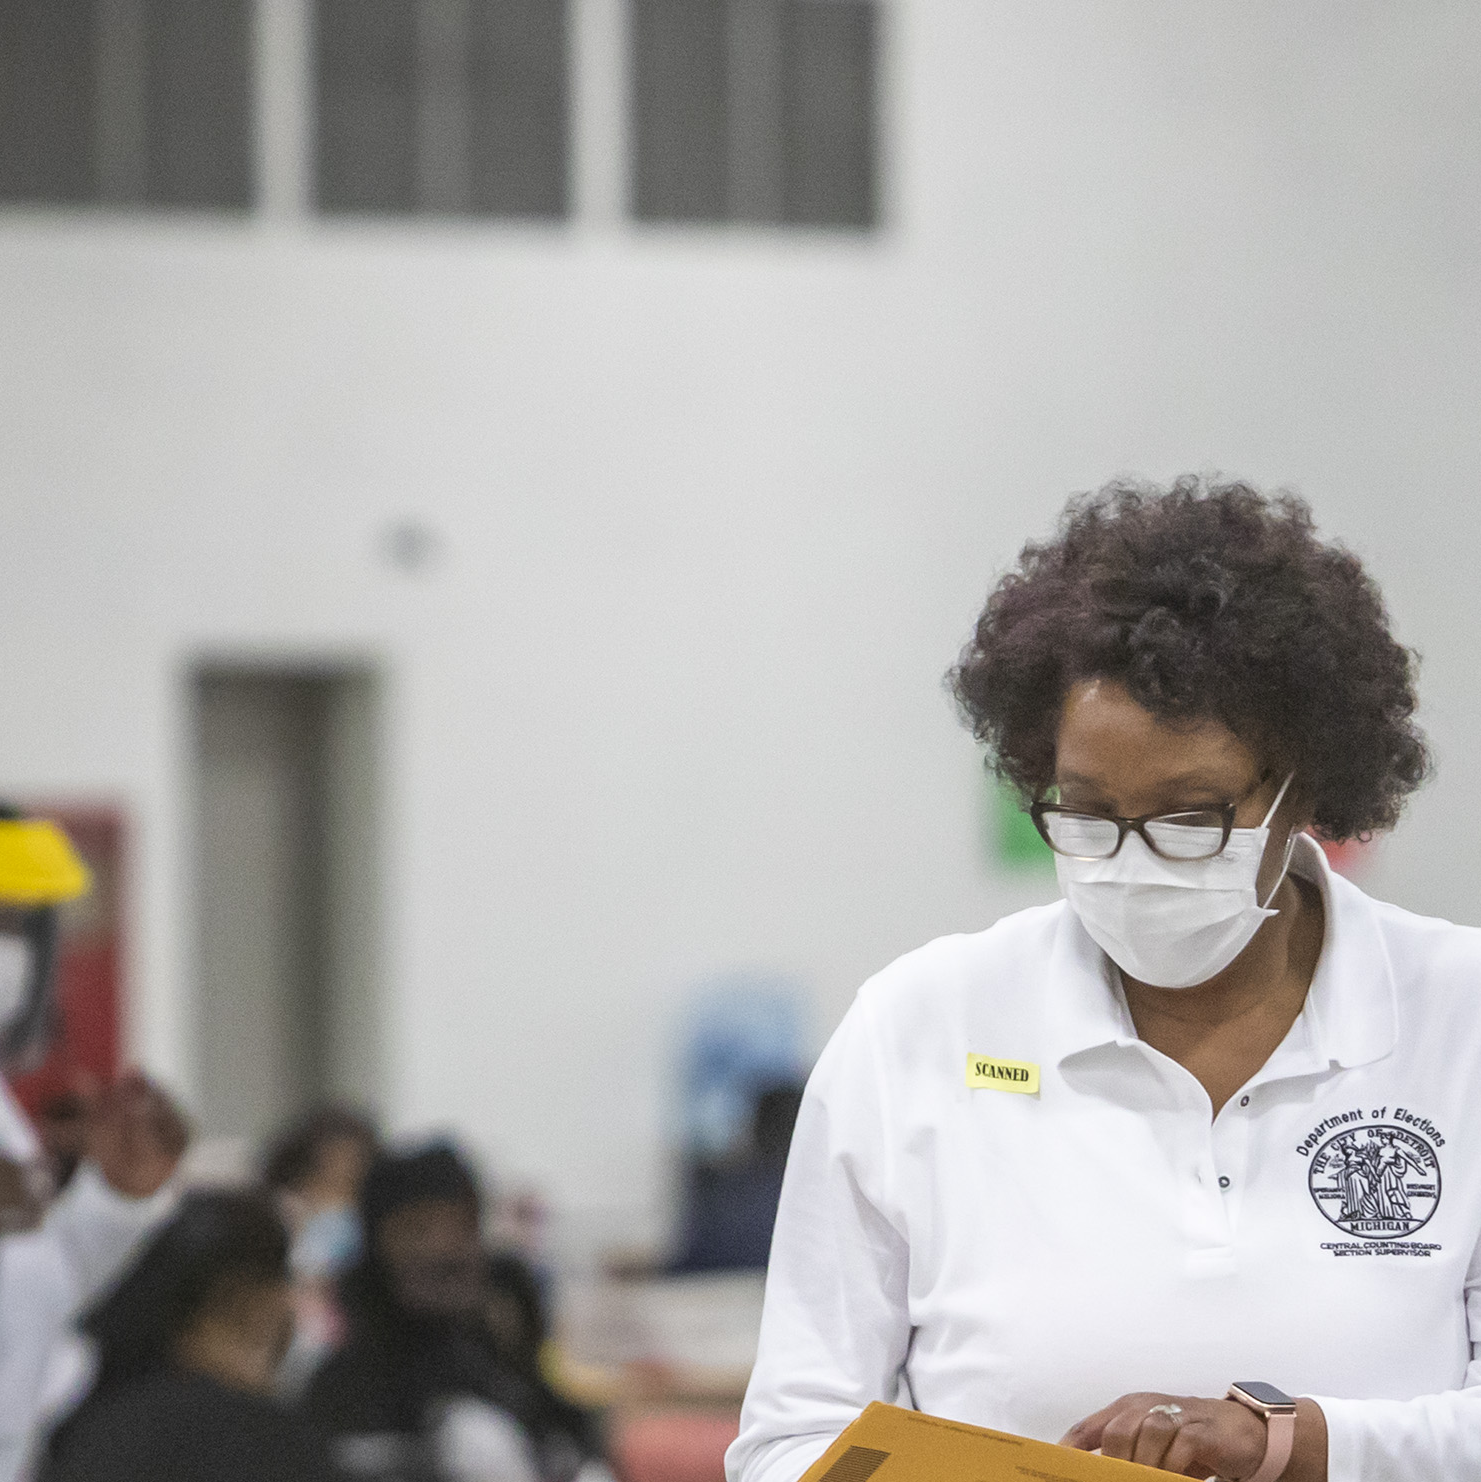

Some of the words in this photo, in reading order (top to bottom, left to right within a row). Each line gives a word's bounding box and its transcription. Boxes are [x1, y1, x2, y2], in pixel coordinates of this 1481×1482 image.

[975, 1062, 1029, 1082] SCANNED
[1296, 1109, 1363, 1157] Department
[1371, 1106, 1387, 1119] of
[1394, 1108, 1445, 1148] Elections
[1313, 1152, 1332, 1175] THE
[1330, 1132, 1357, 1151] CITY
[1396, 1131, 1436, 1169] DETROIT
[1351, 1222, 1409, 1231] MICHIGAN
[1320, 1242, 1363, 1250] CENTRAL
[1363, 1241, 1410, 1249] COUNTING
[1411, 1242, 1442, 1251] BOARD
[1374, 1249, 1431, 1257] SUPERVISOR
